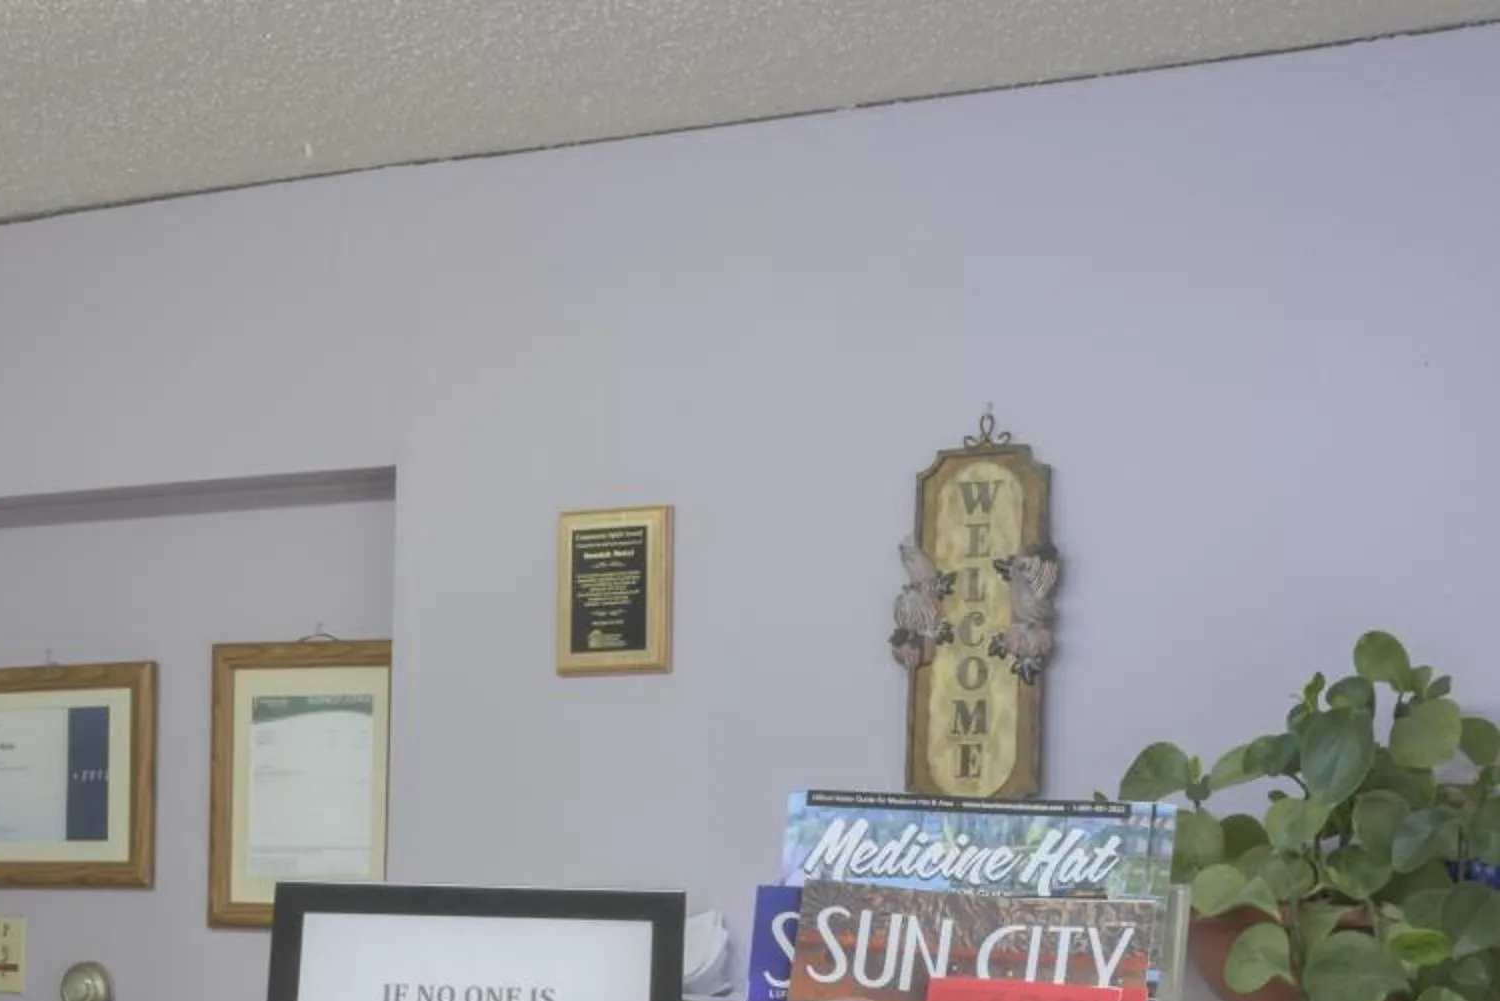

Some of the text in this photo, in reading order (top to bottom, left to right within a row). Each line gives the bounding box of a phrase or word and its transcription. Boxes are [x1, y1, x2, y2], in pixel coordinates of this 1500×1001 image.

[951, 480, 1003, 780] WELCOME
[804, 818, 1122, 897] Medicine Hat
[806, 905, 1135, 992] SUN CITY
